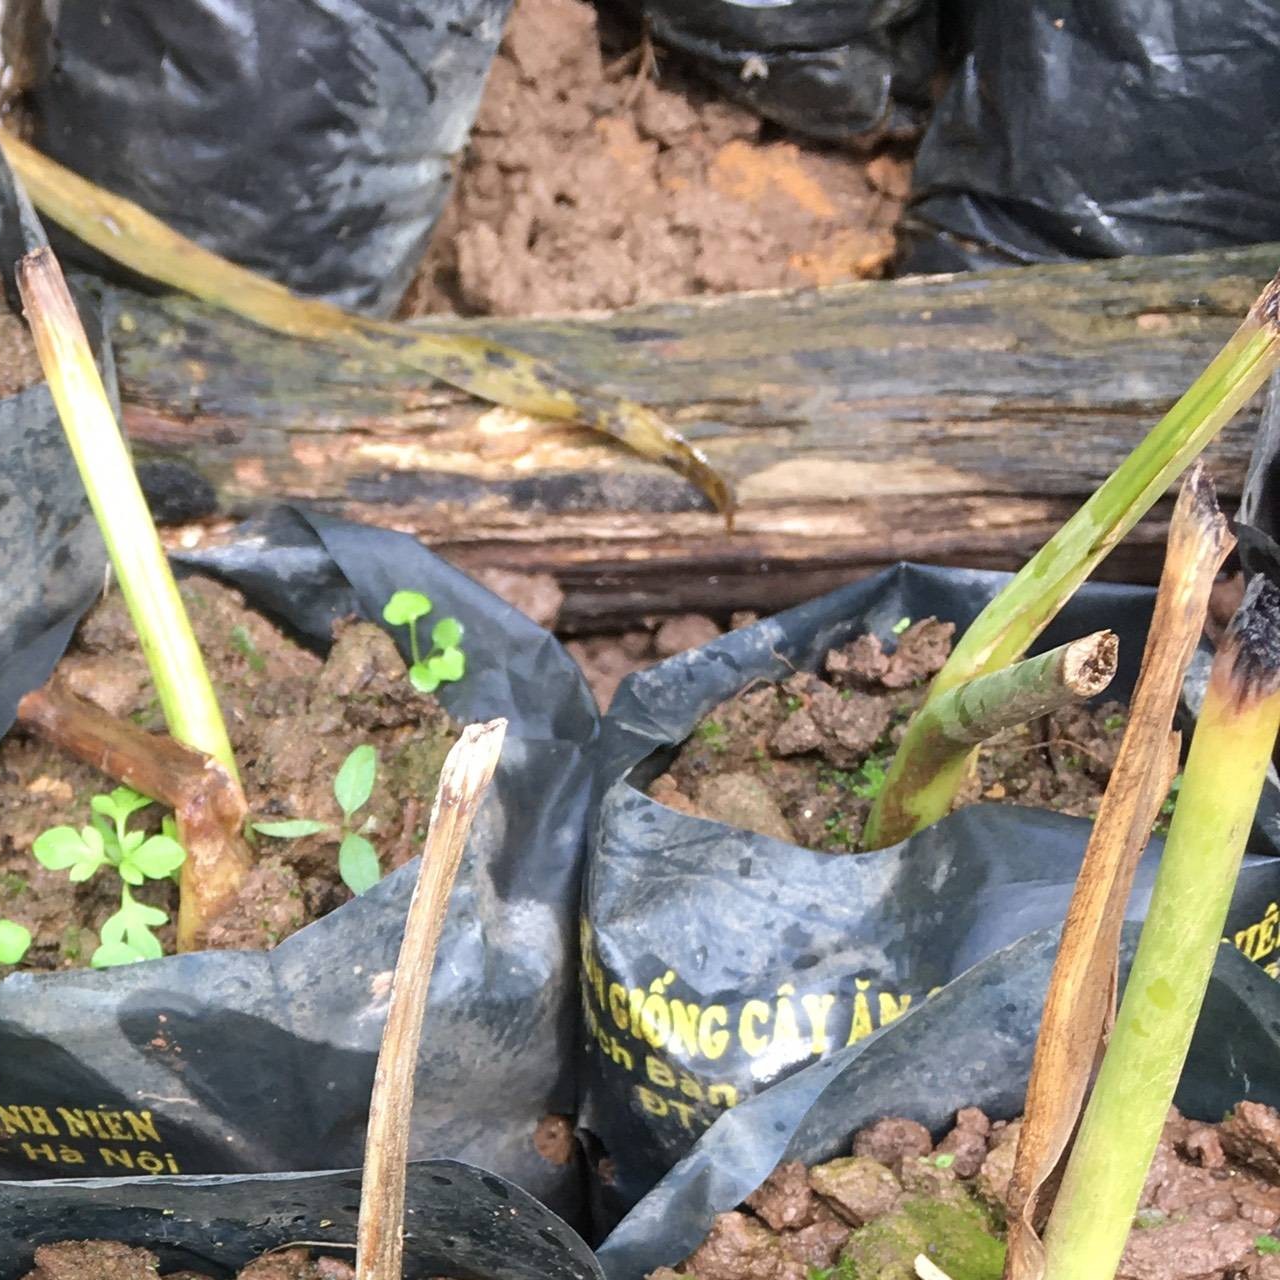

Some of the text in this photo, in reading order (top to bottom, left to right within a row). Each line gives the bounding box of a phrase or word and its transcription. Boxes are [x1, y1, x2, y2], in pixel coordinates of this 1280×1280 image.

[608, 970, 730, 1060] GIỐNG
[738, 983, 835, 1055] CÂY
[21, 1142, 87, 1164] Hà
[98, 1147, 181, 1175] Nội
